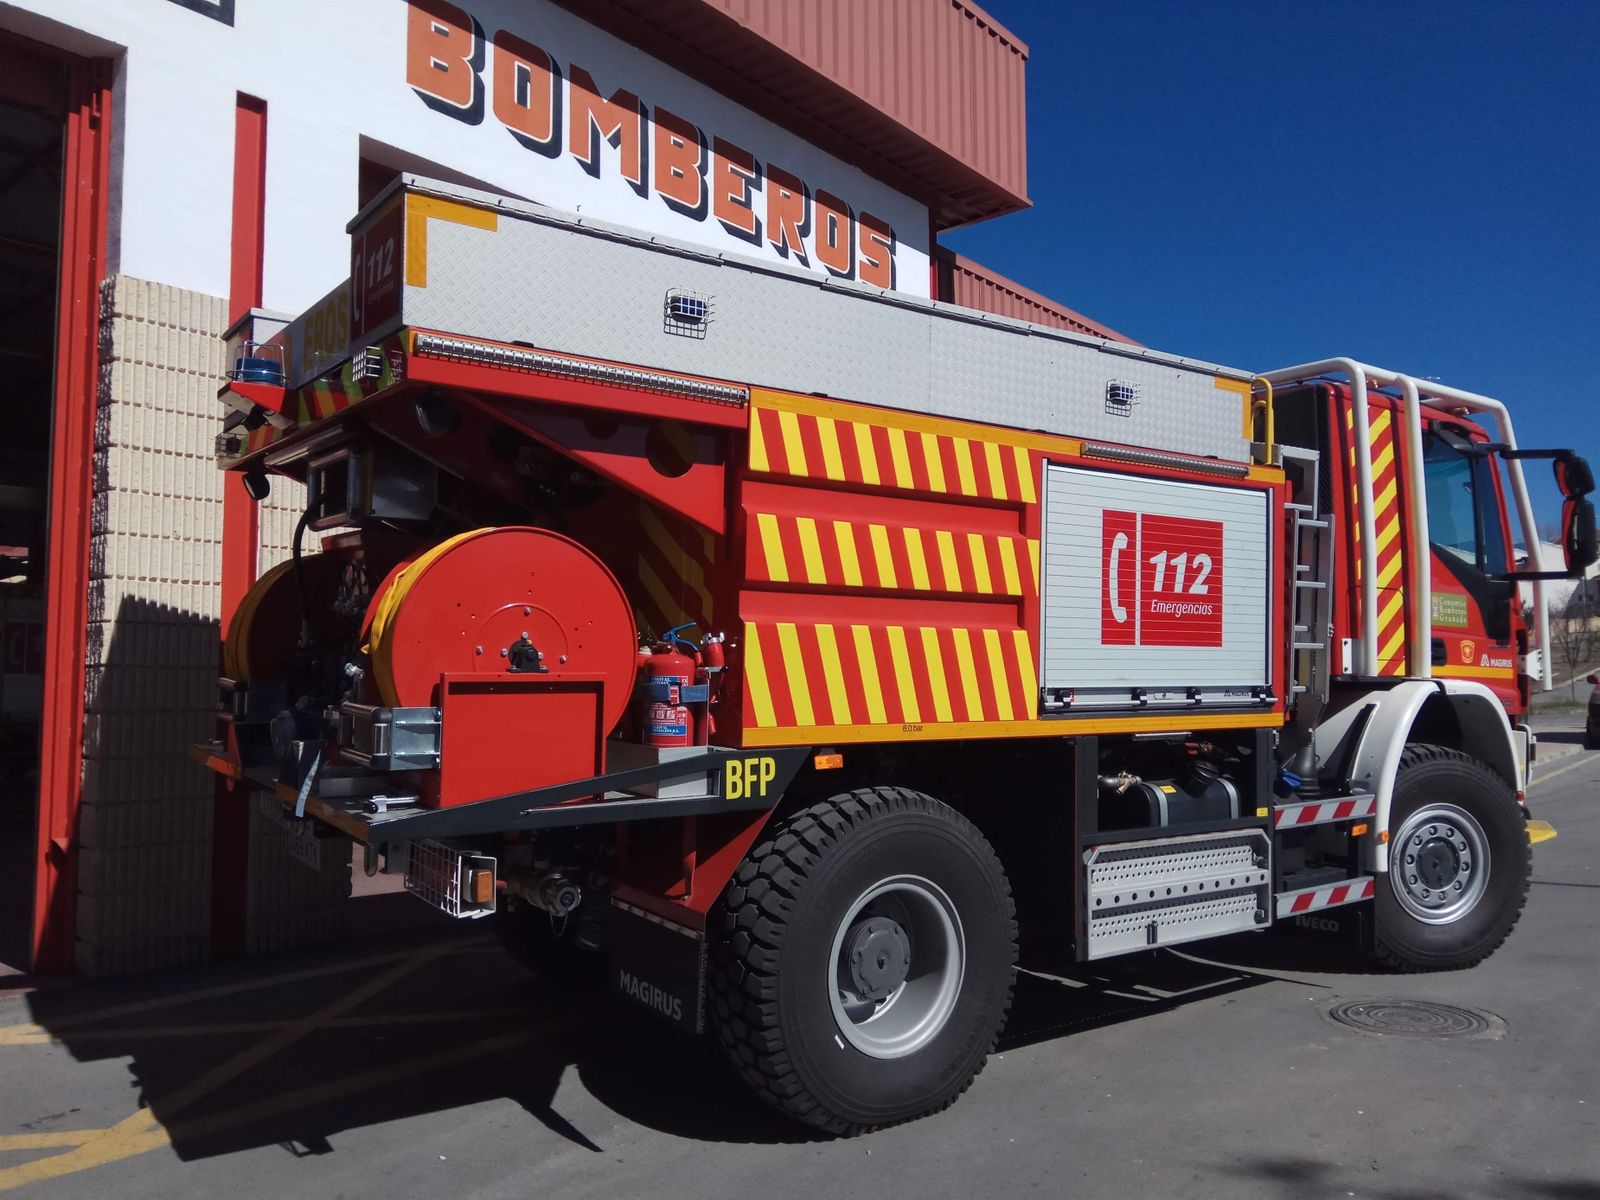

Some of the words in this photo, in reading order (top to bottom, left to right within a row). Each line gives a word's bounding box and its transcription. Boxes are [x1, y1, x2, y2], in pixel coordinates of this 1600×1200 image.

[405, 0, 896, 290] BOMBEROS
[367, 237, 395, 288] 112
[1149, 550, 1213, 595] 112
[1151, 599, 1213, 618] Emergencias
[1439, 613, 1467, 624] Granada
[1490, 658, 1513, 668] MAGIRUS
[912, 724, 923, 732] bar
[725, 756, 776, 800] BFP
[1295, 915, 1340, 932] IVECO
[619, 969, 682, 1021] MAGIRUS
